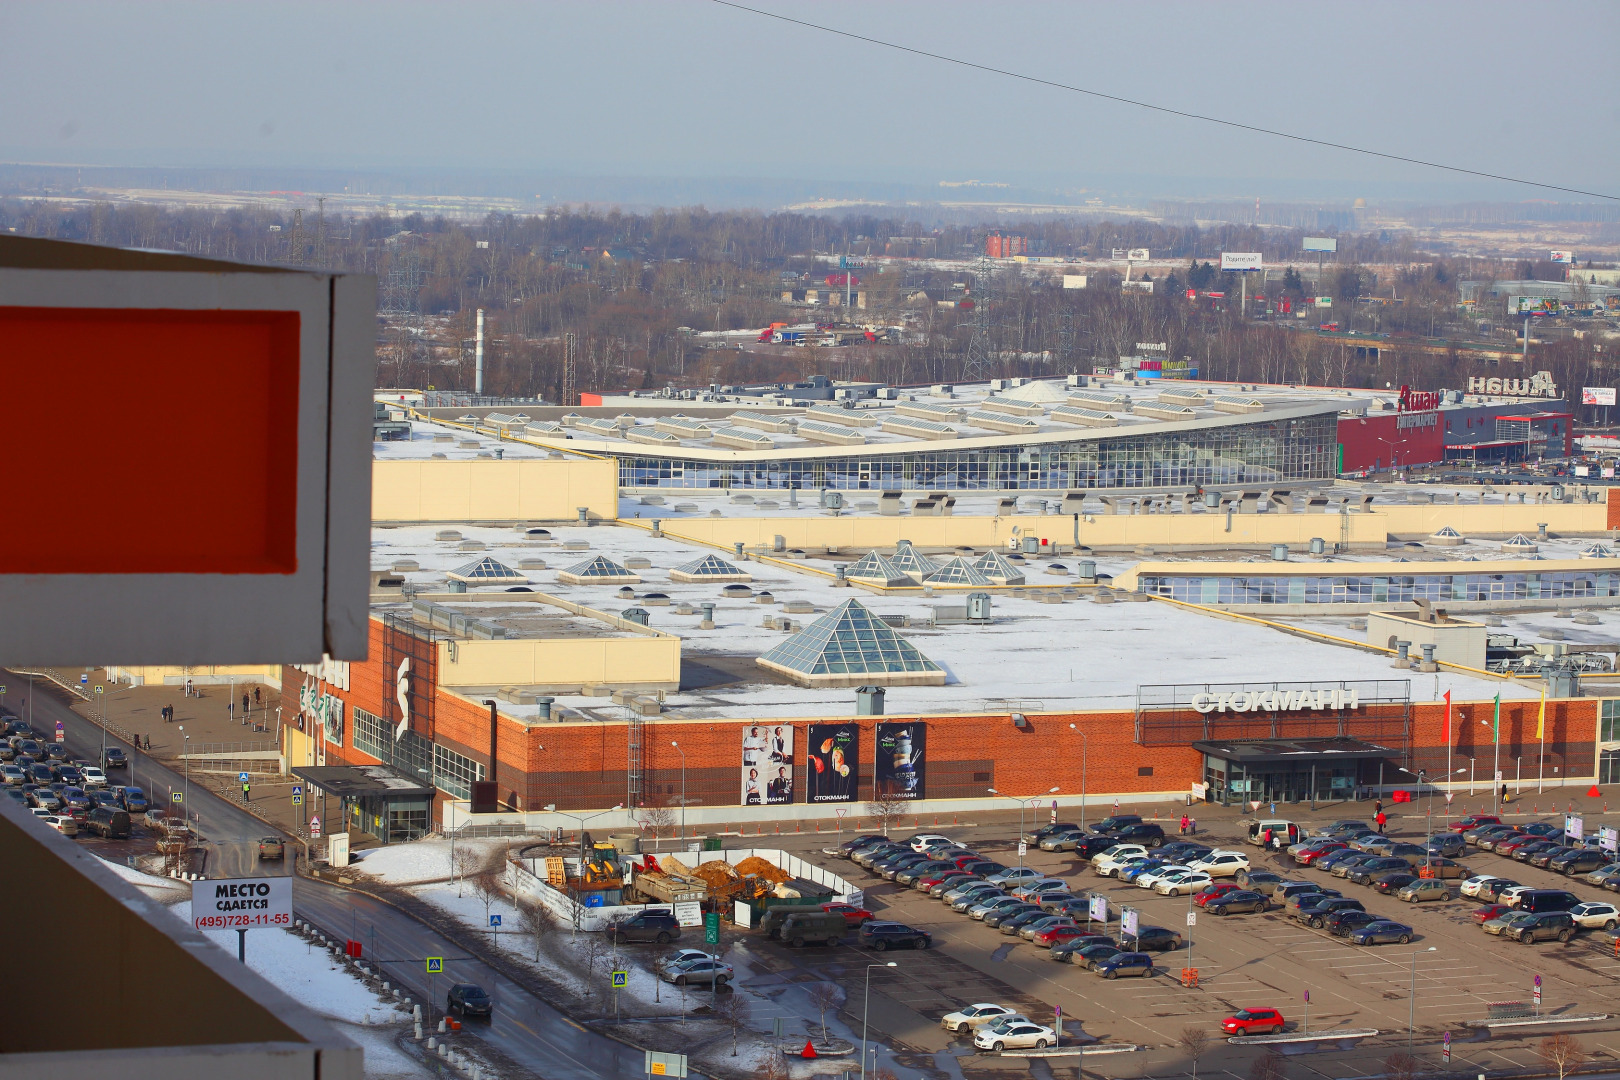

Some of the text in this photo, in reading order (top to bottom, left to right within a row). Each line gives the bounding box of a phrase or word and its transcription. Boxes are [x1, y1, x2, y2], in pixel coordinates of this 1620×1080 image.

[1398, 385, 1439, 412] Ашан
[1191, 690, 1358, 713] СТОКМАНН
[216, 883, 270, 898] МЕСТО
[216, 899, 268, 912] СДАЕТСЯ
[195, 913, 289, 930] (495)728-11-55
